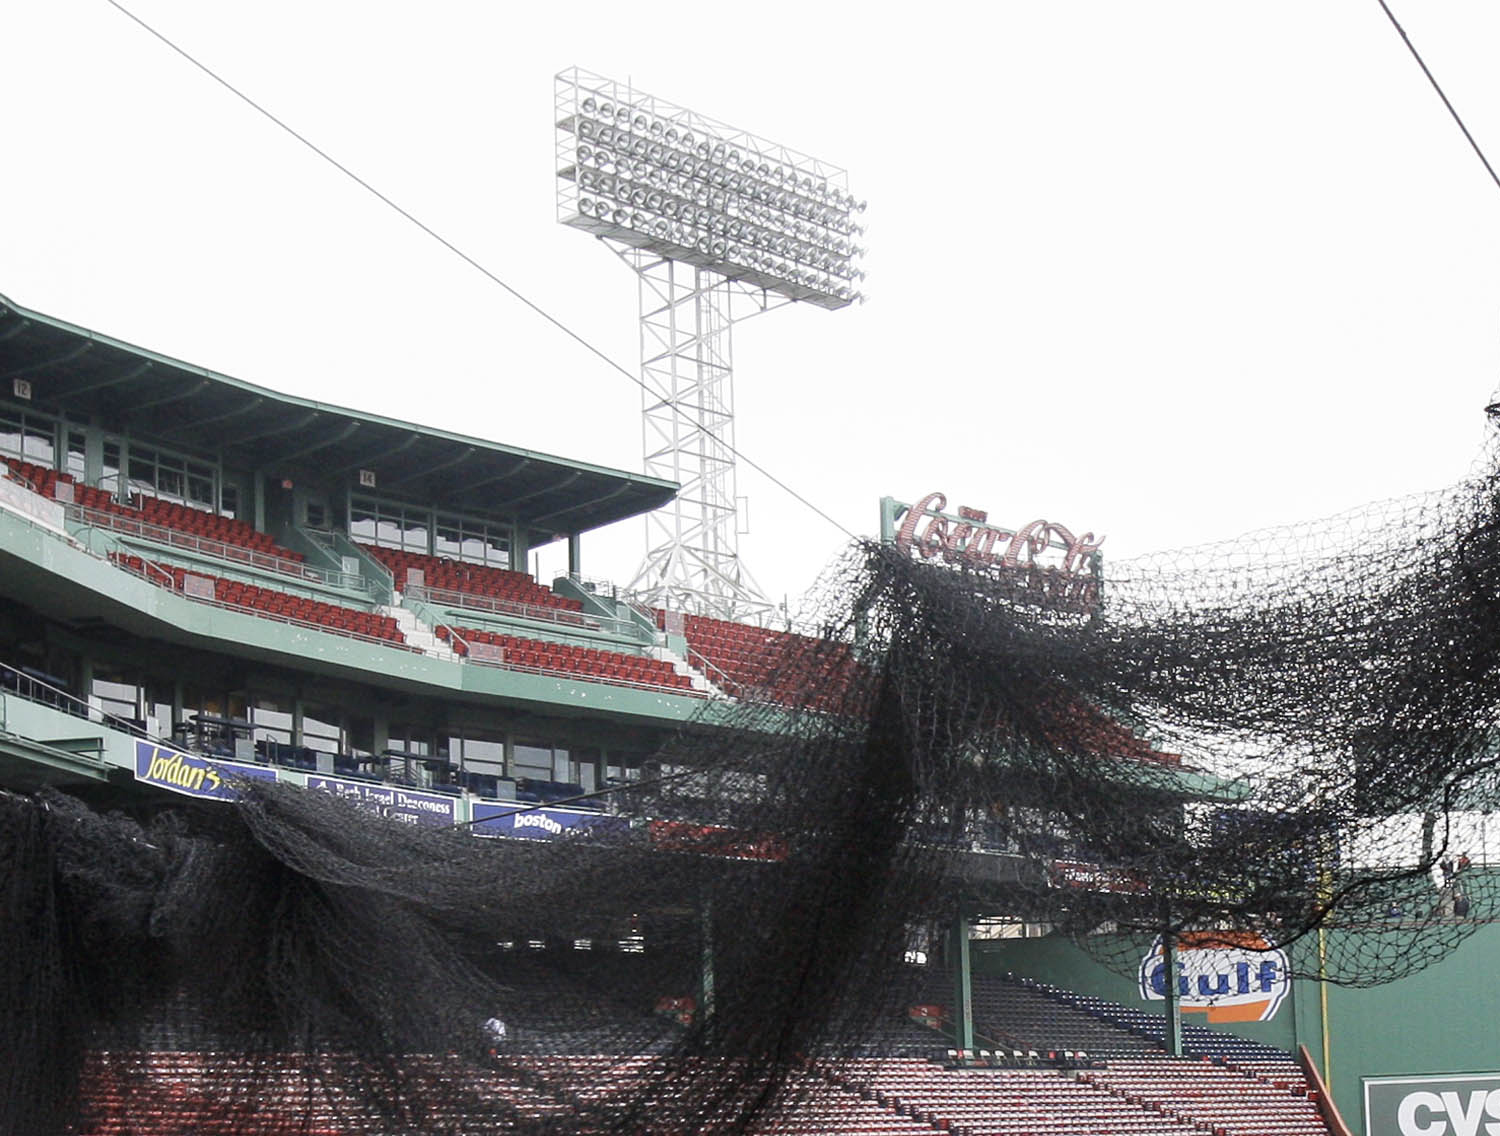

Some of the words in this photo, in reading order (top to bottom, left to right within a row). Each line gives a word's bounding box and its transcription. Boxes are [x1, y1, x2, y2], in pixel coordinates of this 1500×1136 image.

[141, 748, 221, 792] Jordan's
[397, 792, 450, 815] Deaconess
[514, 803, 562, 835] boston
[1151, 961, 1277, 996] Gulf
